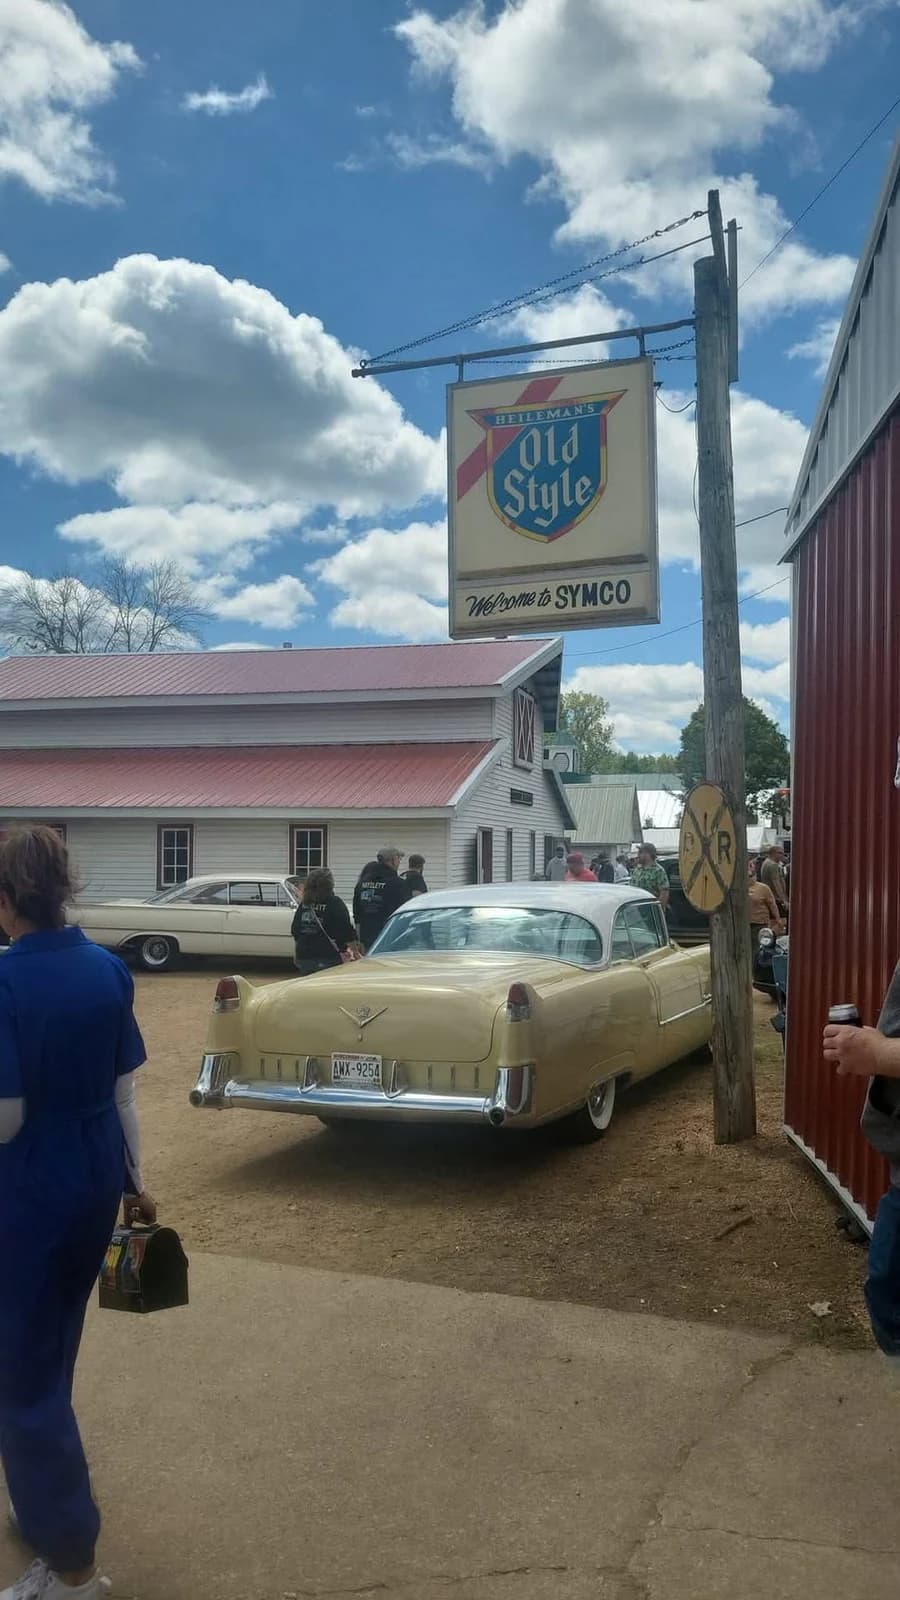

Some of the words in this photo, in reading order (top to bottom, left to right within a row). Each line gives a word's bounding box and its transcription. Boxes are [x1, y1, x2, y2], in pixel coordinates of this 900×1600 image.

[495, 403, 595, 425] HEILEMAN'S
[520, 422, 579, 471] Old
[503, 467, 594, 528] Style
[465, 591, 537, 617] Welcome
[537, 587, 552, 607] to
[555, 579, 632, 609] SYMCO
[717, 830, 732, 865] R
